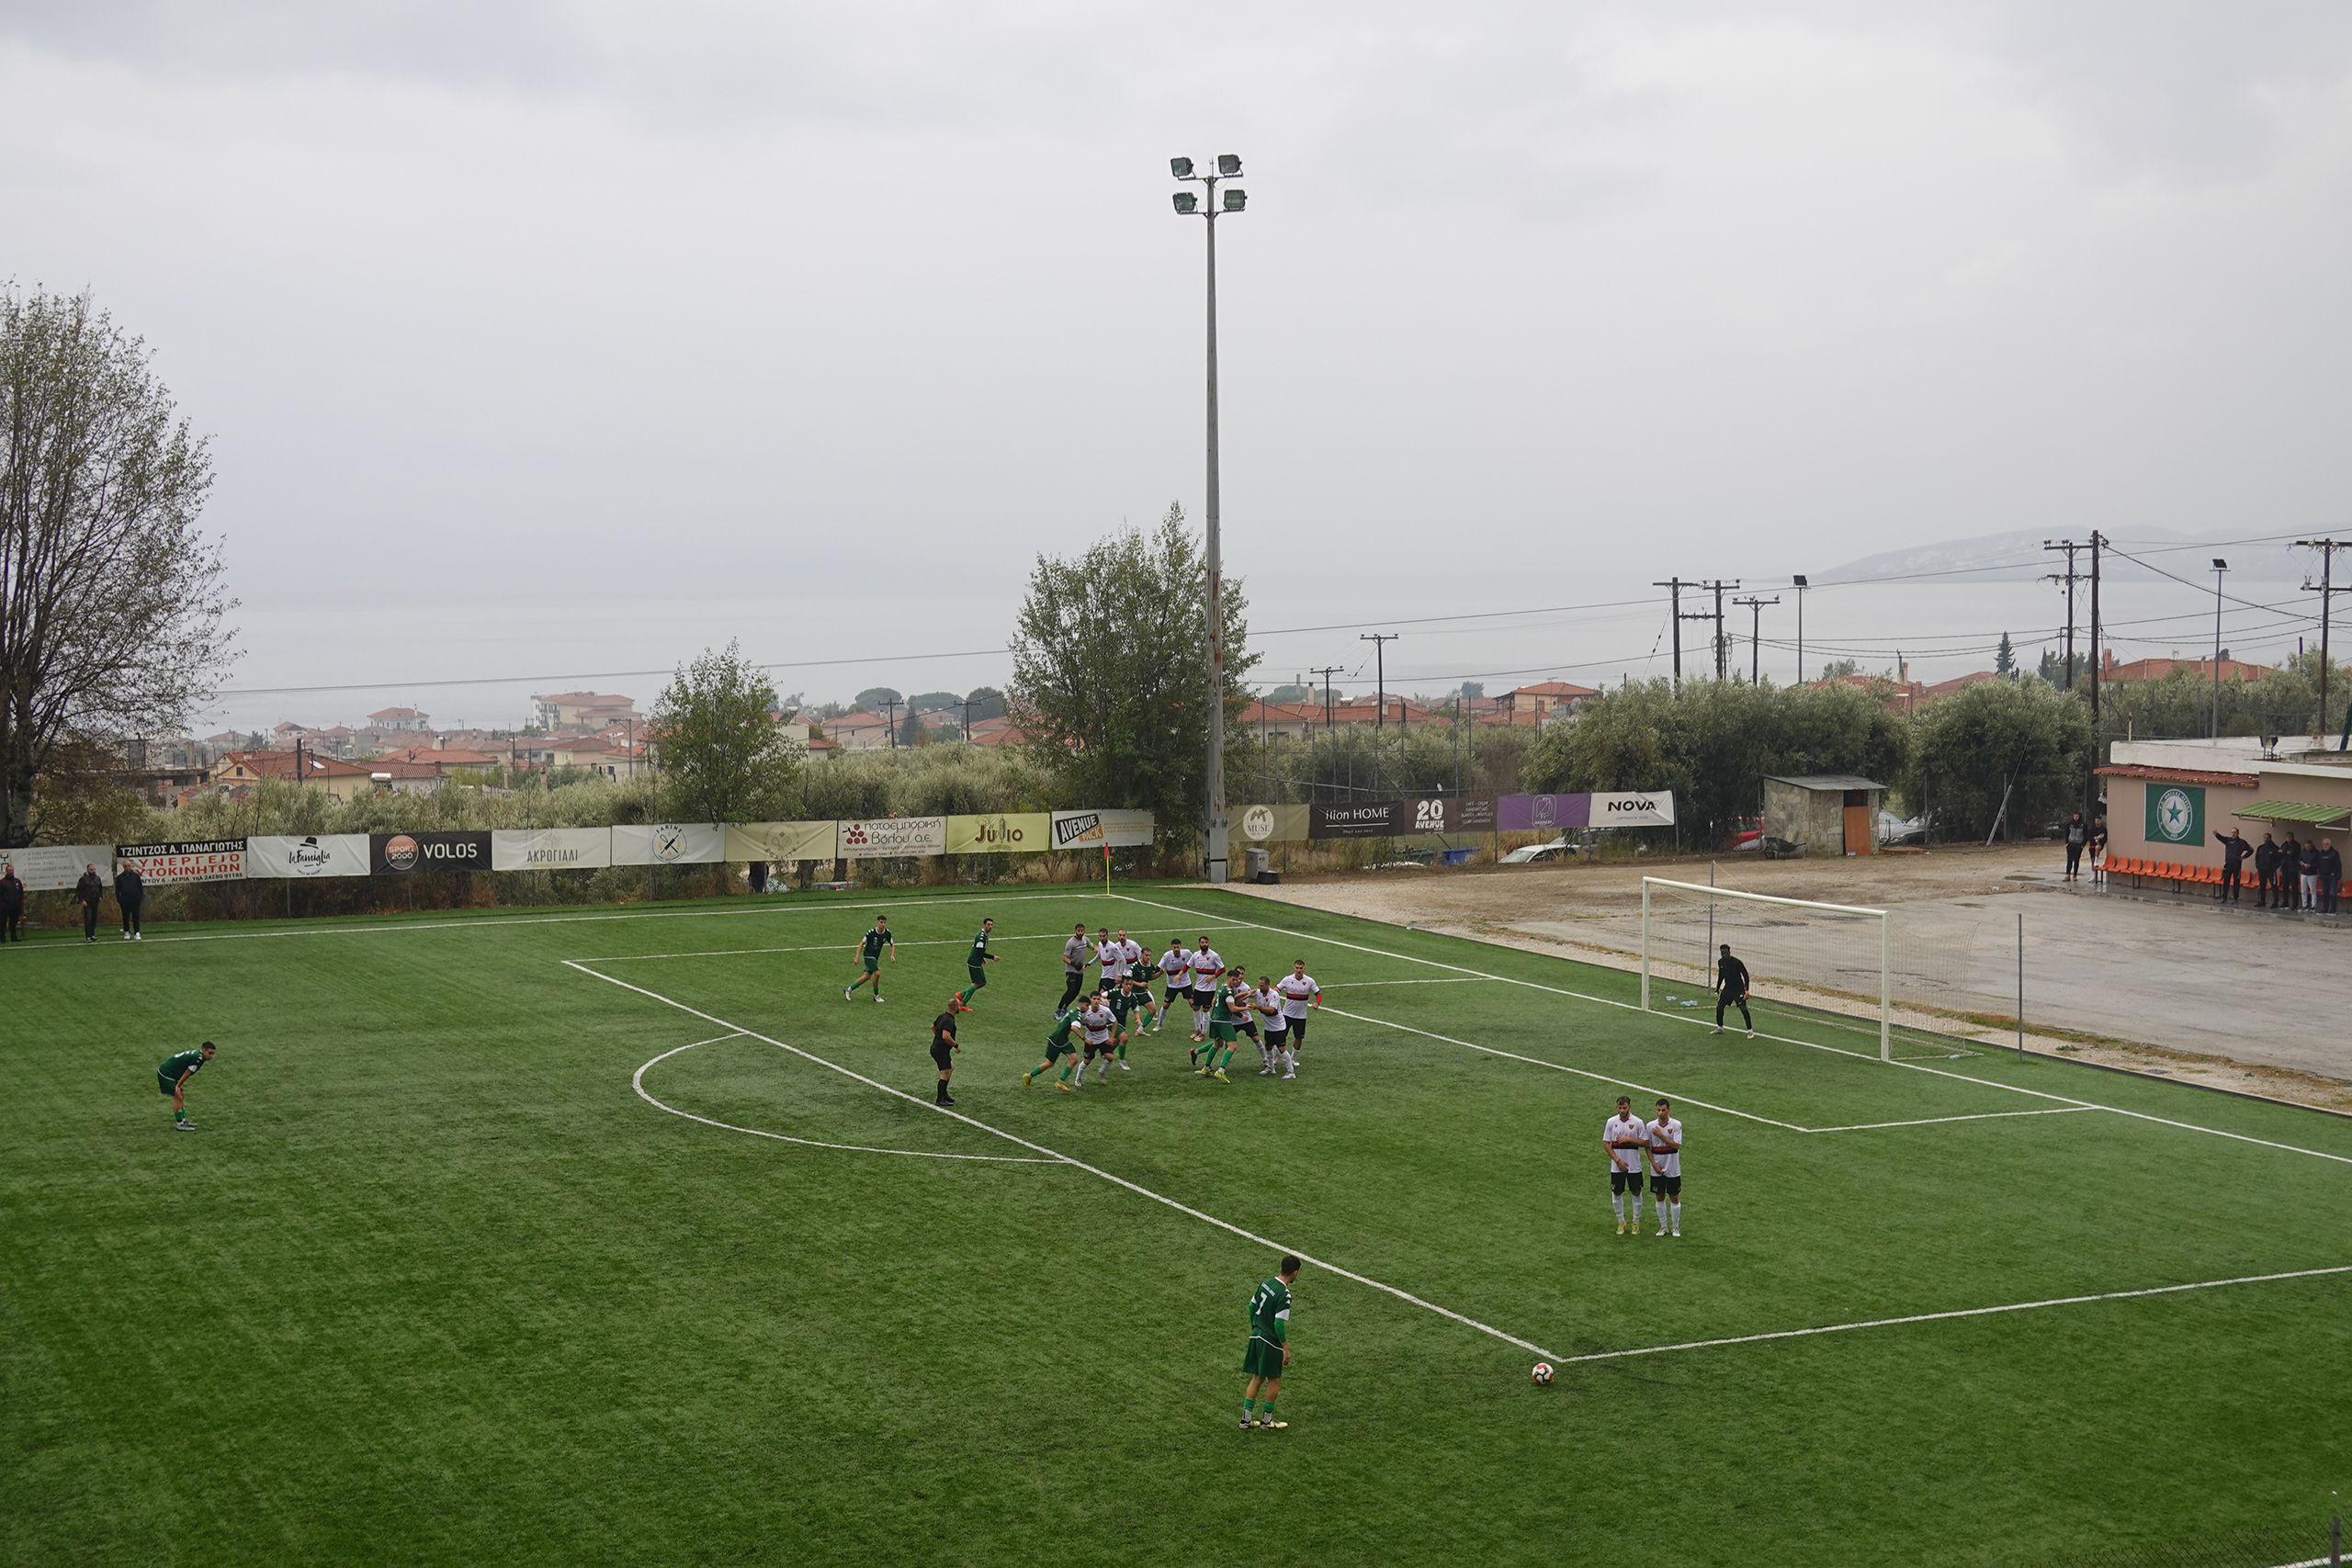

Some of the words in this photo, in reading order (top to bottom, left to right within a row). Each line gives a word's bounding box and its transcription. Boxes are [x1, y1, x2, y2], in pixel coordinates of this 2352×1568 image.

[1353, 807, 1389, 819] HOME
[1417, 799, 1443, 820] 20
[1608, 800, 1657, 812] NOVA
[1059, 815, 1097, 843] AVENUE
[1415, 820, 1444, 829] AVENUE
[120, 844, 167, 856] ΤΖΙΝΤΖΟΣ
[182, 840, 244, 854] ΠΑΝΑΓΙΩΤΗΣ
[389, 845, 415, 853] SPORT
[423, 843, 478, 860] VOLOS
[131, 853, 241, 868] ΥΝΕΡΓΕΙΟ
[527, 849, 578, 863] ΑΚΡΟΓΙΑΛΙ
[135, 863, 240, 877] ΥΤΟΚΙΝΗΤΩΝ
